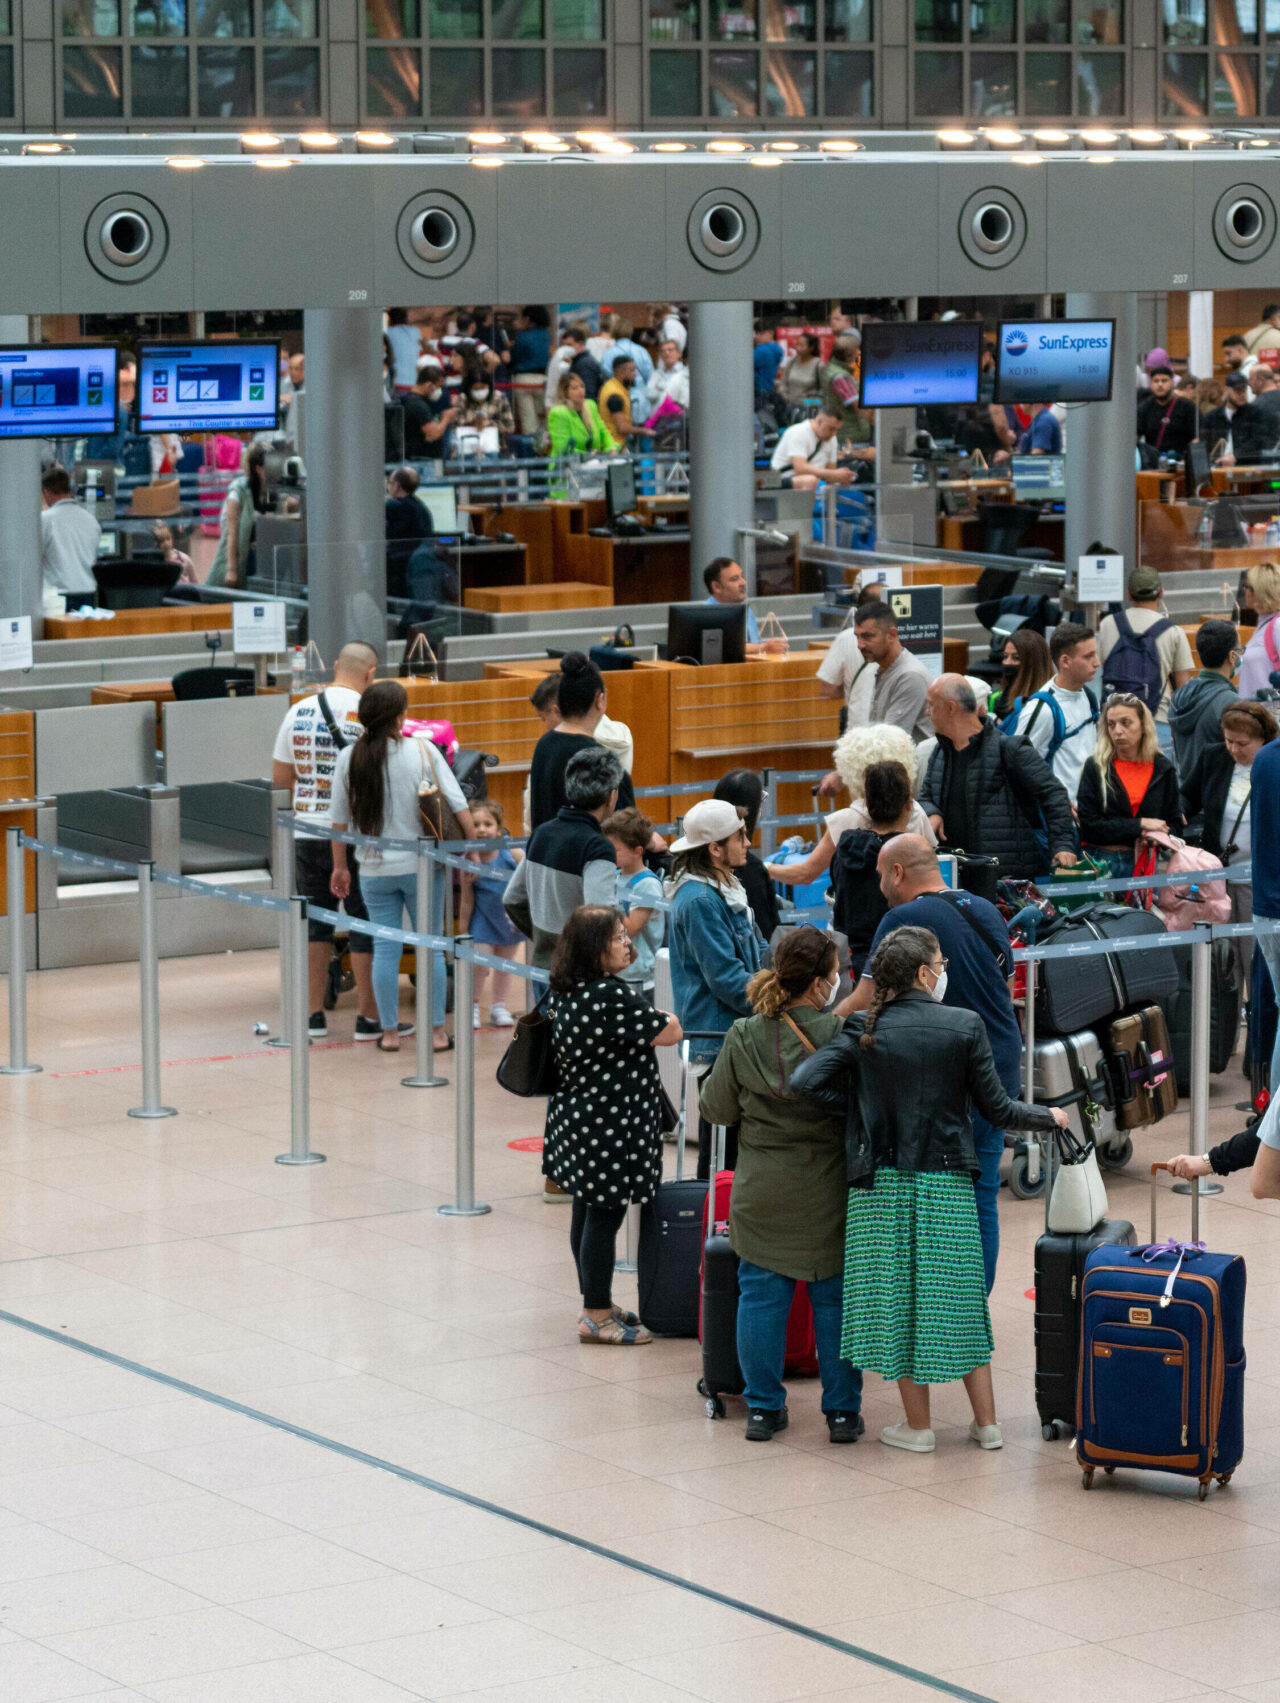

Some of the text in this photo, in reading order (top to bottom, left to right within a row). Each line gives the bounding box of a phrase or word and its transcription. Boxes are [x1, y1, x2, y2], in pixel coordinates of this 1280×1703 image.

[1173, 274, 1188, 284] 207
[788, 282, 805, 292] 208
[348, 290, 367, 300] 209
[1039, 335, 1108, 352] SunExpress
[189, 419, 204, 428] This
[205, 418, 233, 428] Counter
[235, 418, 241, 426] is
[243, 416, 266, 426] closed
